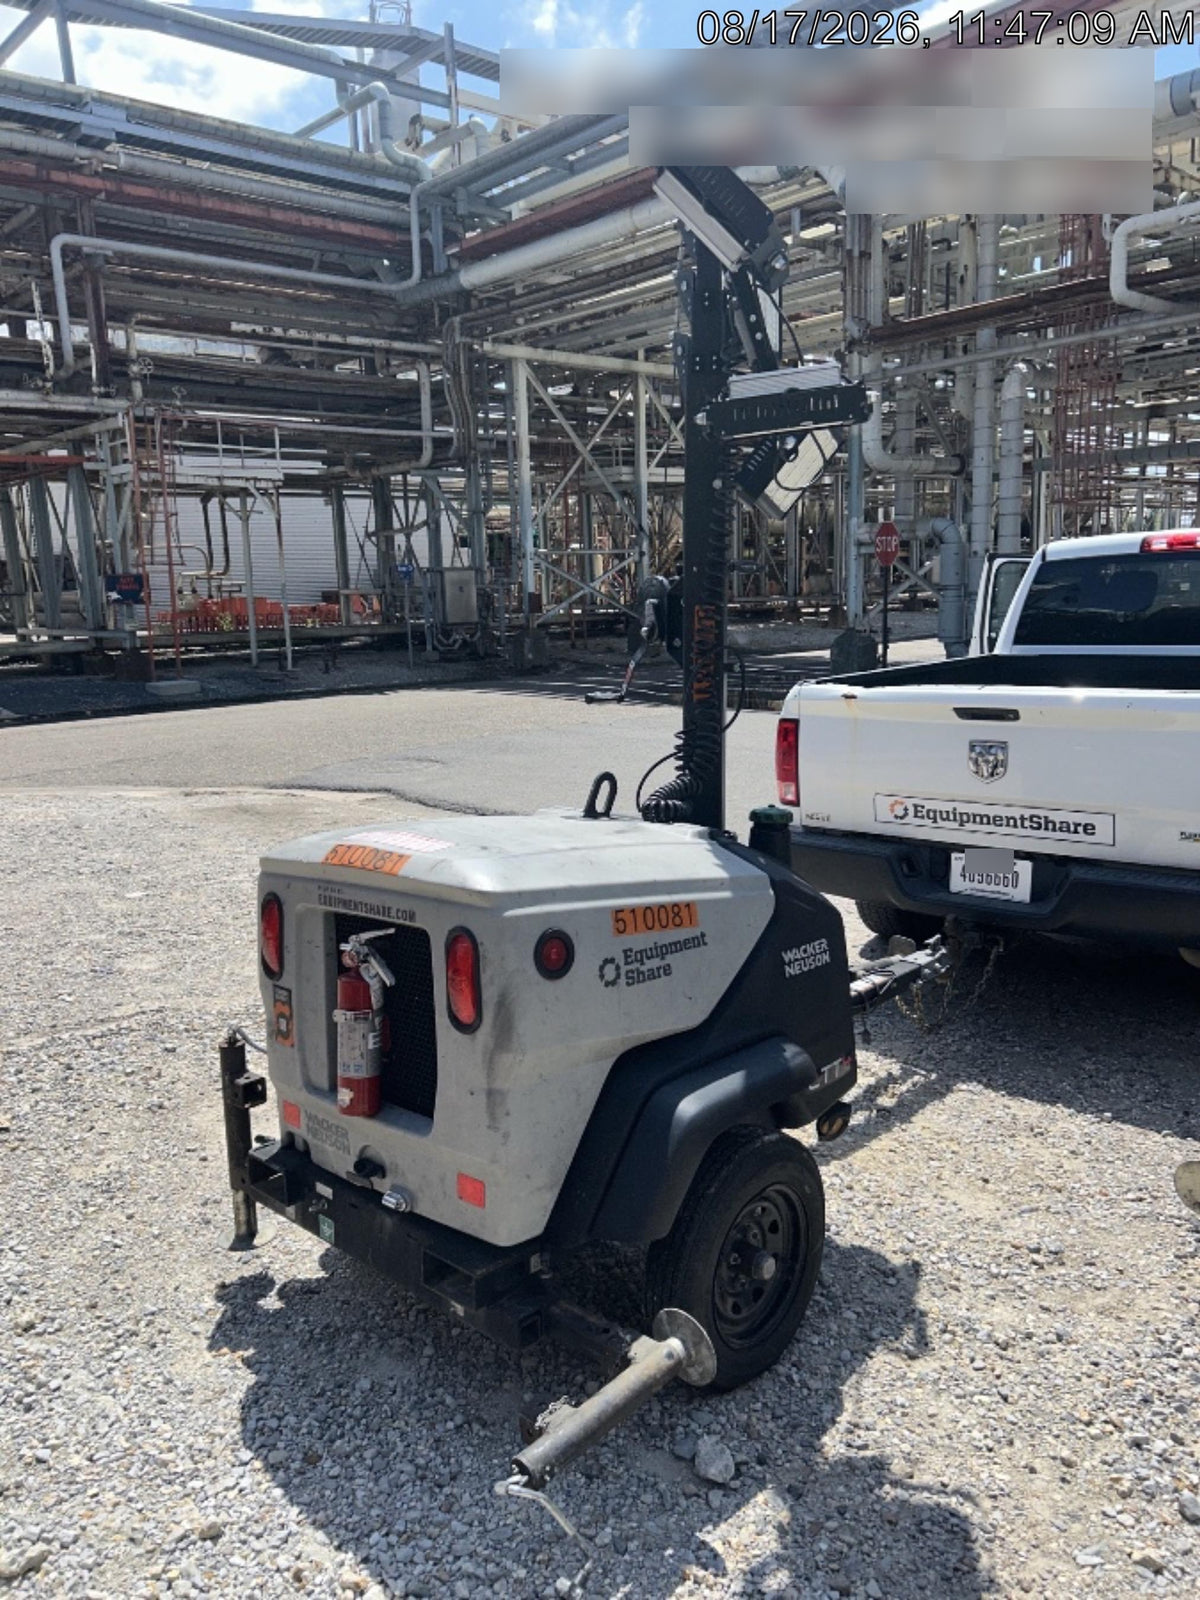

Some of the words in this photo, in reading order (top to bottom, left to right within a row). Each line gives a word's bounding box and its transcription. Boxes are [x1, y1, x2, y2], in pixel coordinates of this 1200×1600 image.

[876, 536, 899, 552] STOP
[912, 803, 1096, 836] EquipmentShare
[318, 893, 416, 922] EQUIPMENTSHARE.COM
[614, 903, 693, 934] 510081
[622, 931, 708, 966] Equipment
[781, 938, 829, 964] WACKER
[625, 963, 672, 987] Share
[784, 950, 831, 979] NEUSON
